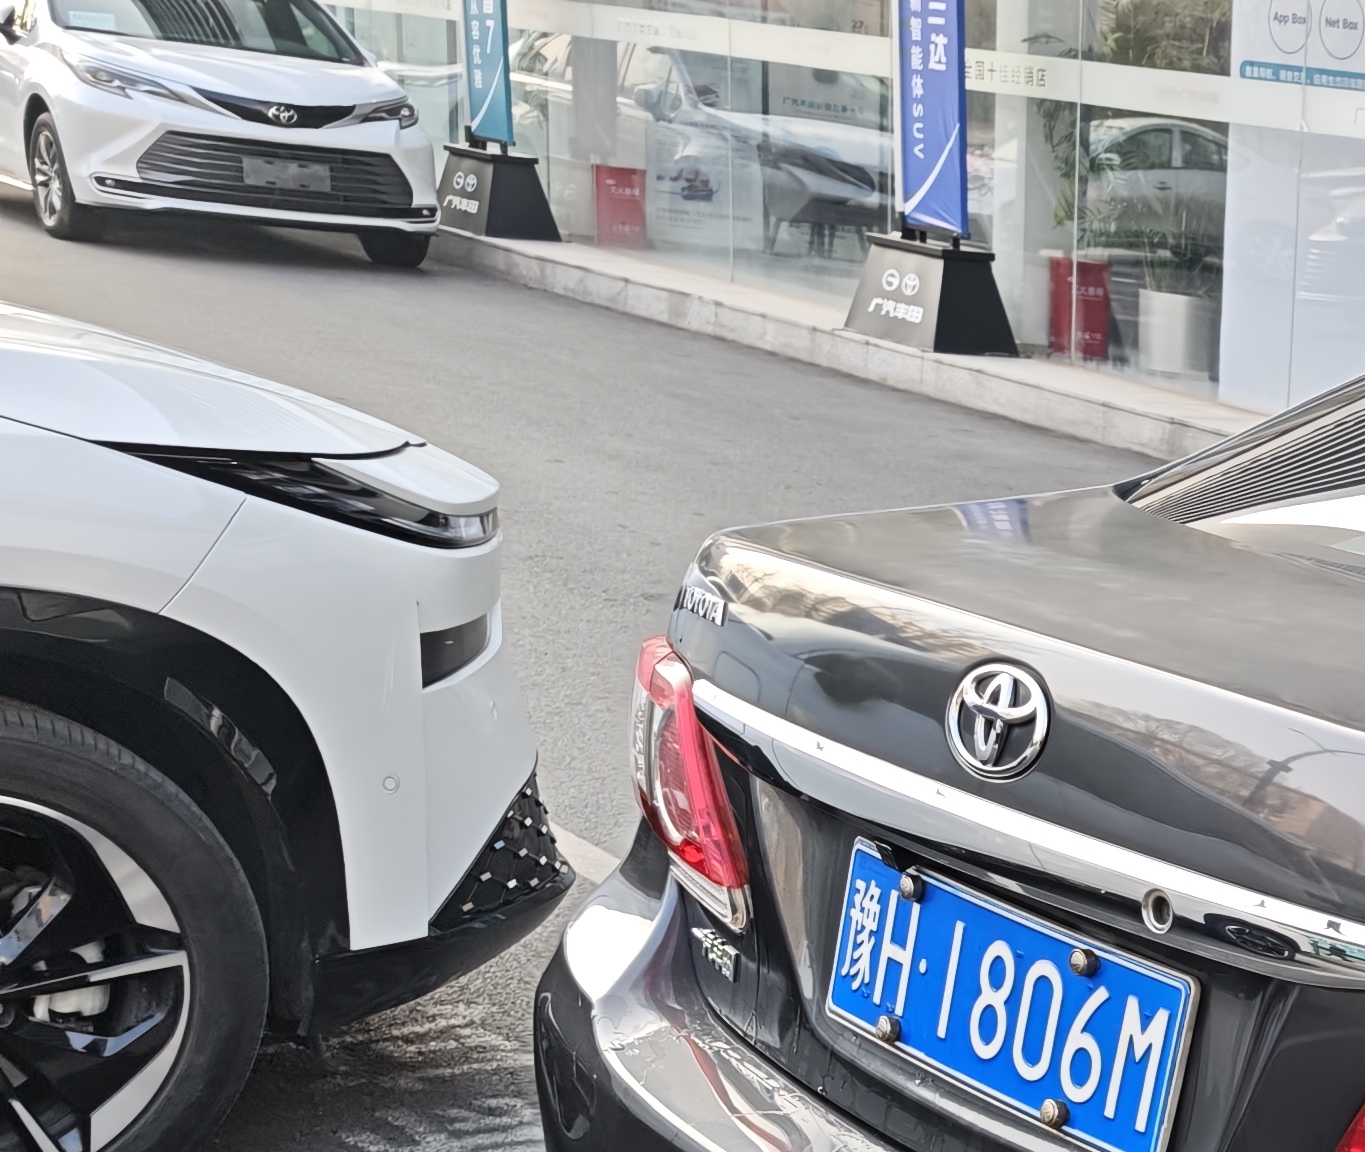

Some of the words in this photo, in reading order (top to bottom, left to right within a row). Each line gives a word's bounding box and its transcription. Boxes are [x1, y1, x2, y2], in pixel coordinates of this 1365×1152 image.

[1273, 12, 1289, 26] App
[1325, 16, 1340, 29] Net
[1342, 18, 1359, 31] Box
[867, 297, 925, 324] 广汽丰田
[682, 584, 726, 627] TOYOTA
